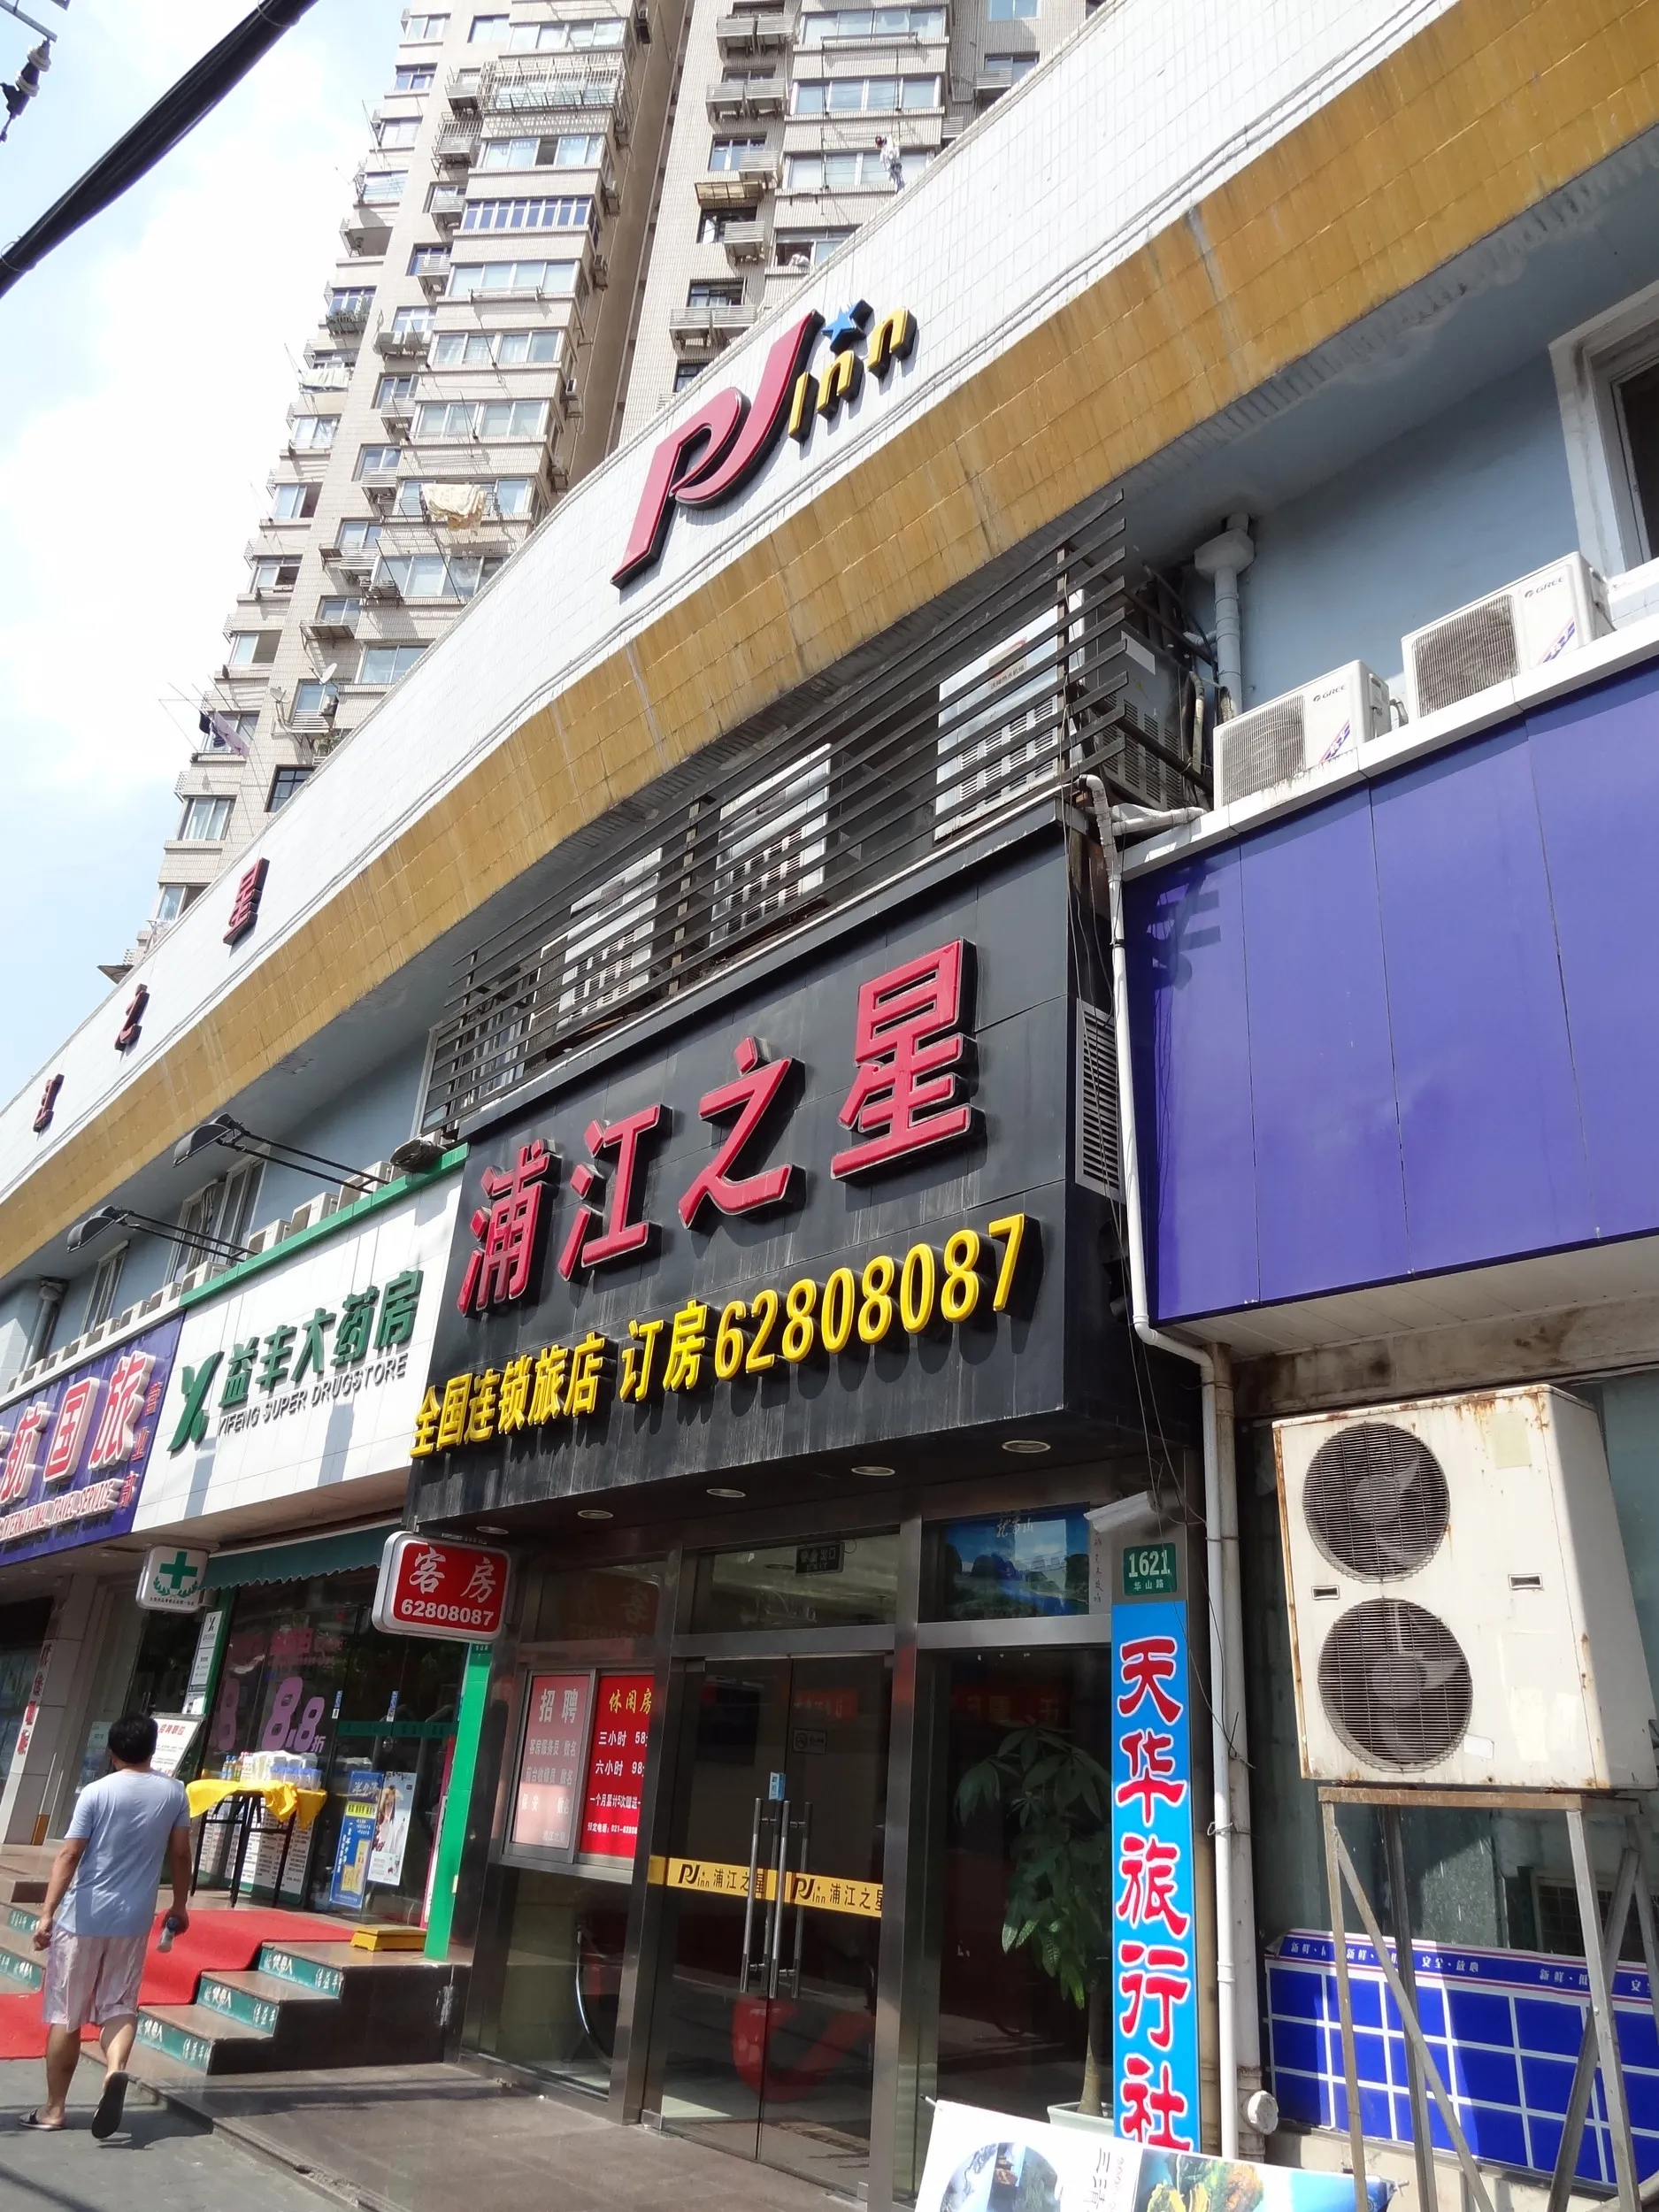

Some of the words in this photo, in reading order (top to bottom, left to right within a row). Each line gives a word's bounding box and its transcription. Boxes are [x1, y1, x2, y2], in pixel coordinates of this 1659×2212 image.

[1536, 576, 1565, 594] GREE
[1322, 684, 1346, 699] GREE
[457, 935, 985, 1318] 浦江之星
[219, 1270, 424, 1409] 益丰大药房
[217, 1410, 259, 1437] YIFENG
[262, 1388, 309, 1424] SUPER
[311, 1352, 409, 1406] DRUGSTORE
[410, 1333, 605, 1458] 全国连锁旅店
[409, 1547, 496, 1604] 客房
[1127, 1549, 1171, 1578] 1621
[1133, 1578, 1164, 1591] 华山路
[401, 1598, 495, 1627] 62808087
[538, 1688, 579, 1724] 招聘
[609, 1687, 652, 1715] 休闲房
[529, 1739, 560, 1757] 客房服务员
[598, 1732, 626, 1747] 三小时
[595, 1759, 623, 1777] 六小时
[713, 1868, 765, 1894] 浦江之星
[1115, 1636, 1194, 2152] 天华旅行社
